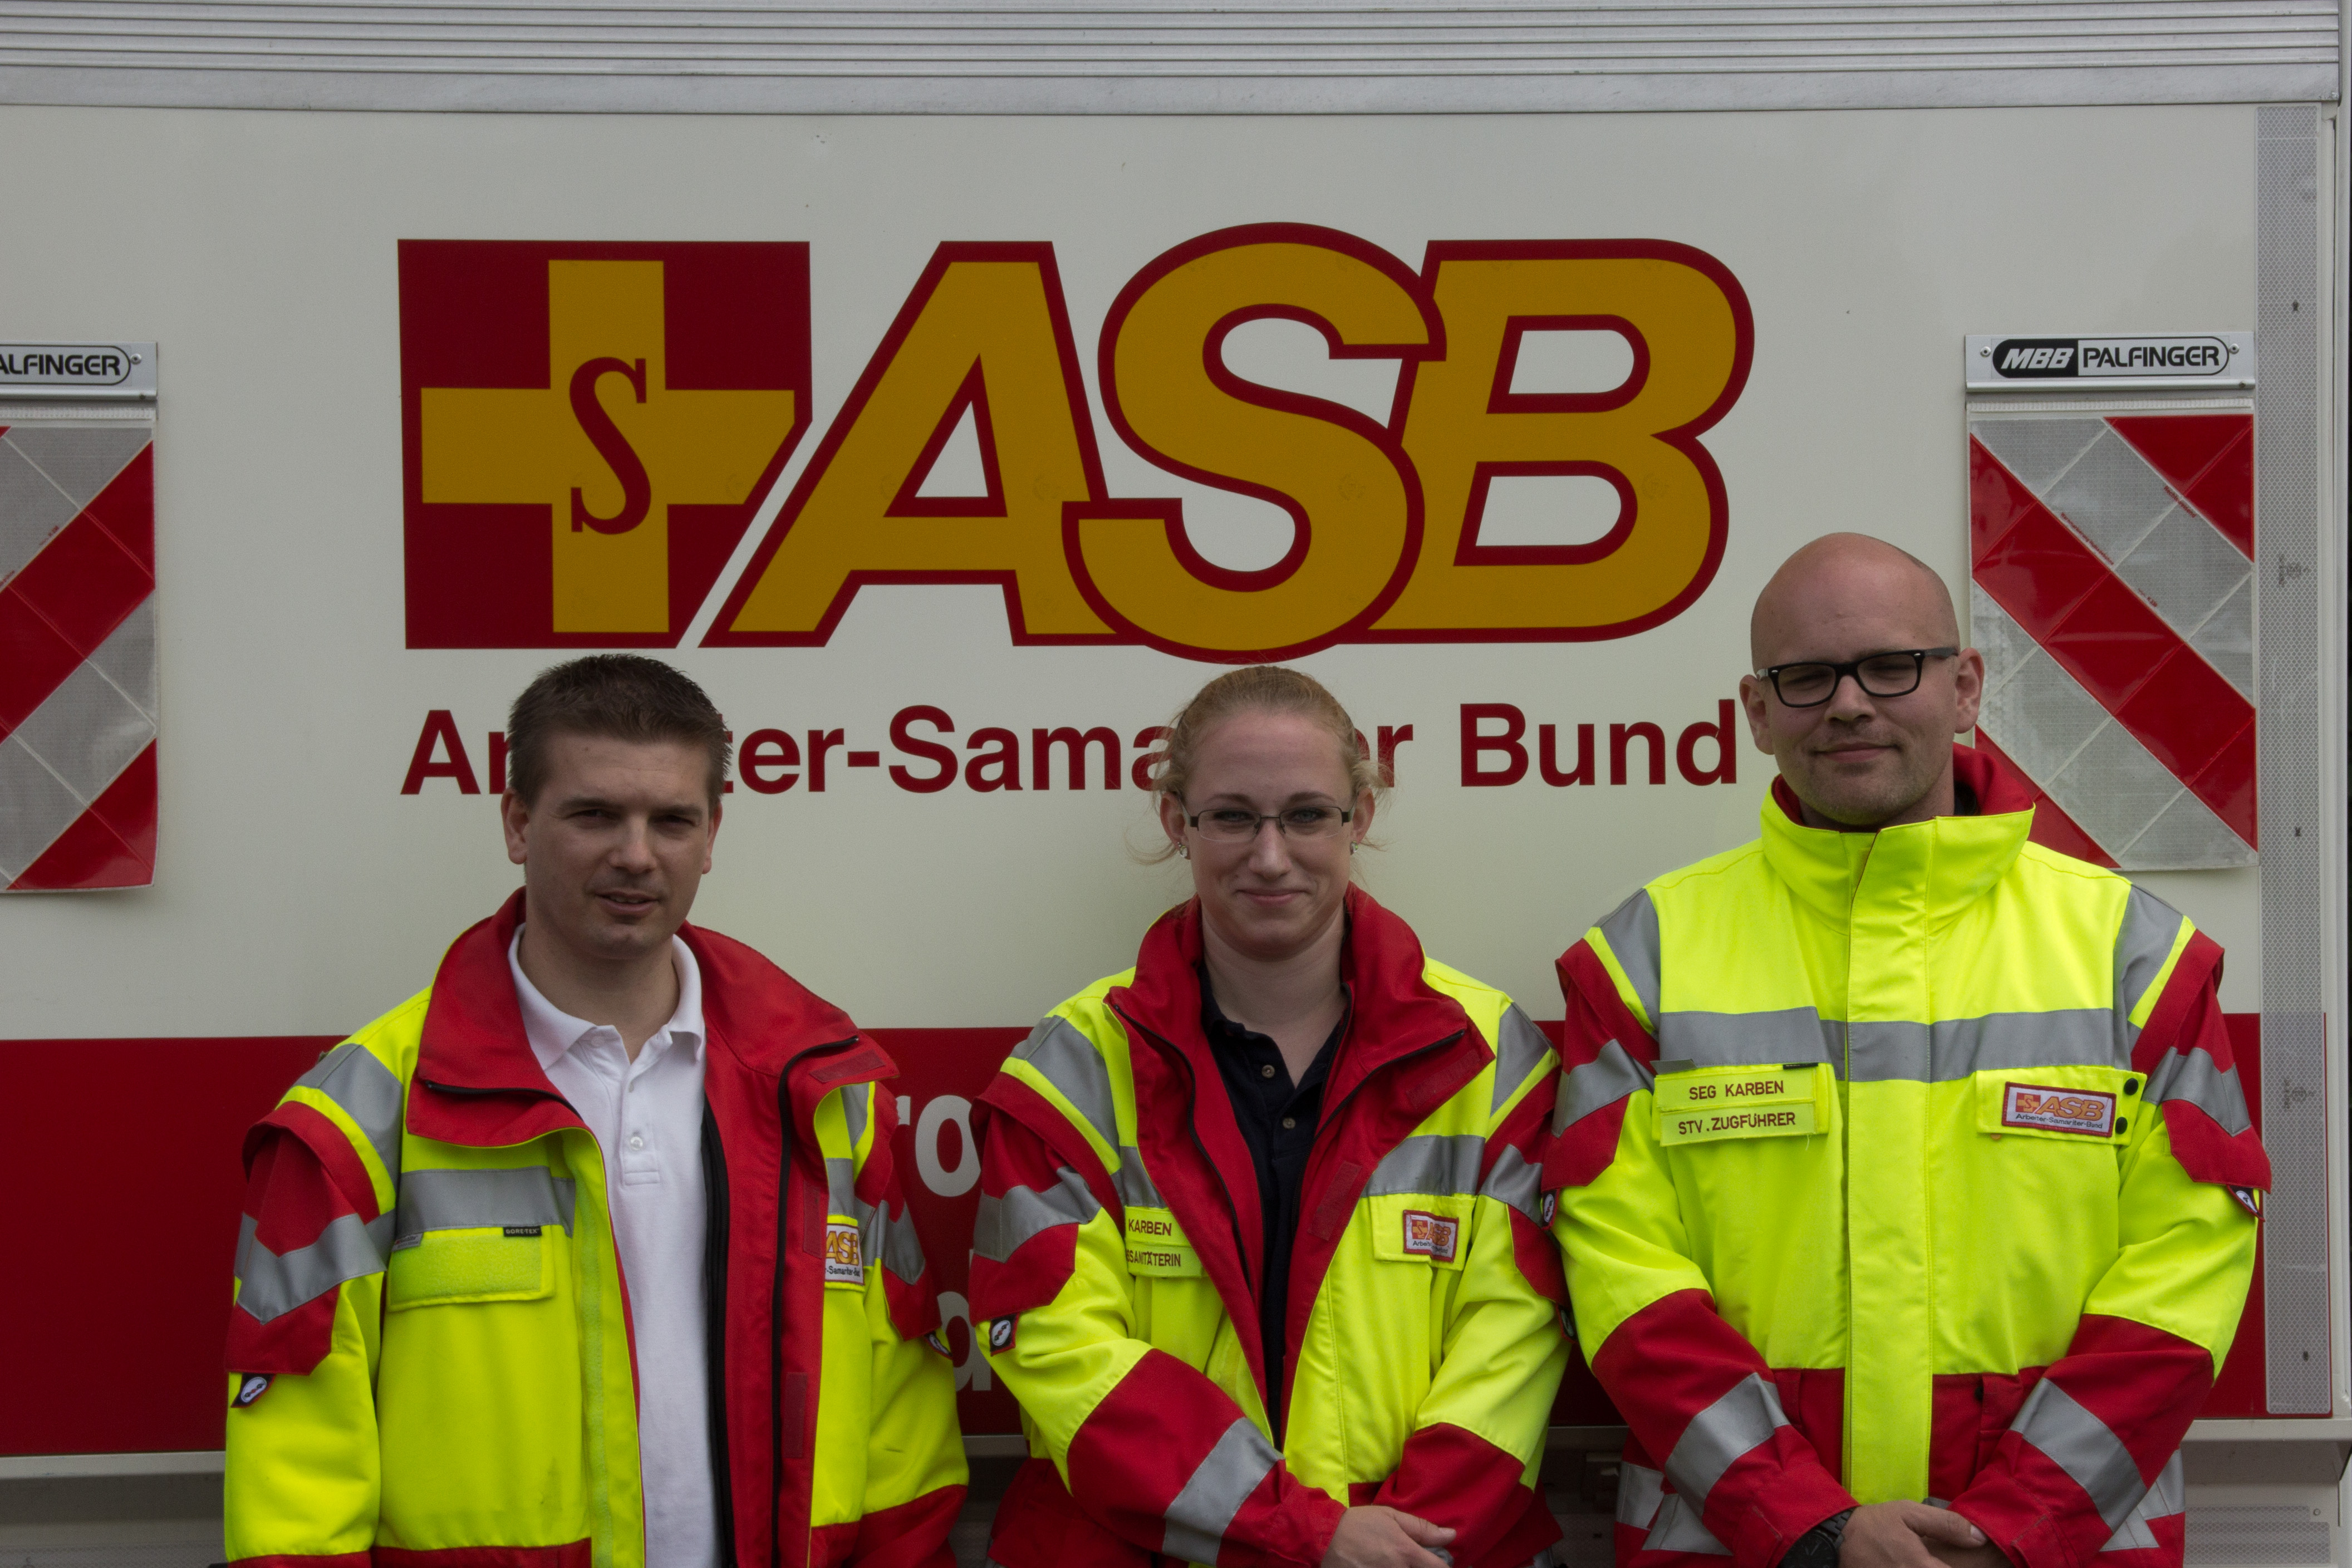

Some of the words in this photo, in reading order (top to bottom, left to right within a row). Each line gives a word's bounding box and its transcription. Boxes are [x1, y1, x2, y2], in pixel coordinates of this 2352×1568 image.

[2001, 348, 2074, 369] MBB
[2083, 346, 2220, 368] PALFINGER
[568, 356, 652, 536] S
[699, 223, 1755, 665] ASB
[1460, 699, 1737, 787] Bund
[1688, 1086, 1716, 1100] SEG
[1725, 1080, 1784, 1097] KARBEN
[2015, 1113, 2103, 1129] Arbeiter-Samariter-Bund
[2035, 1096, 2105, 1122] ASB
[1128, 1218, 1172, 1236] KARBEN
